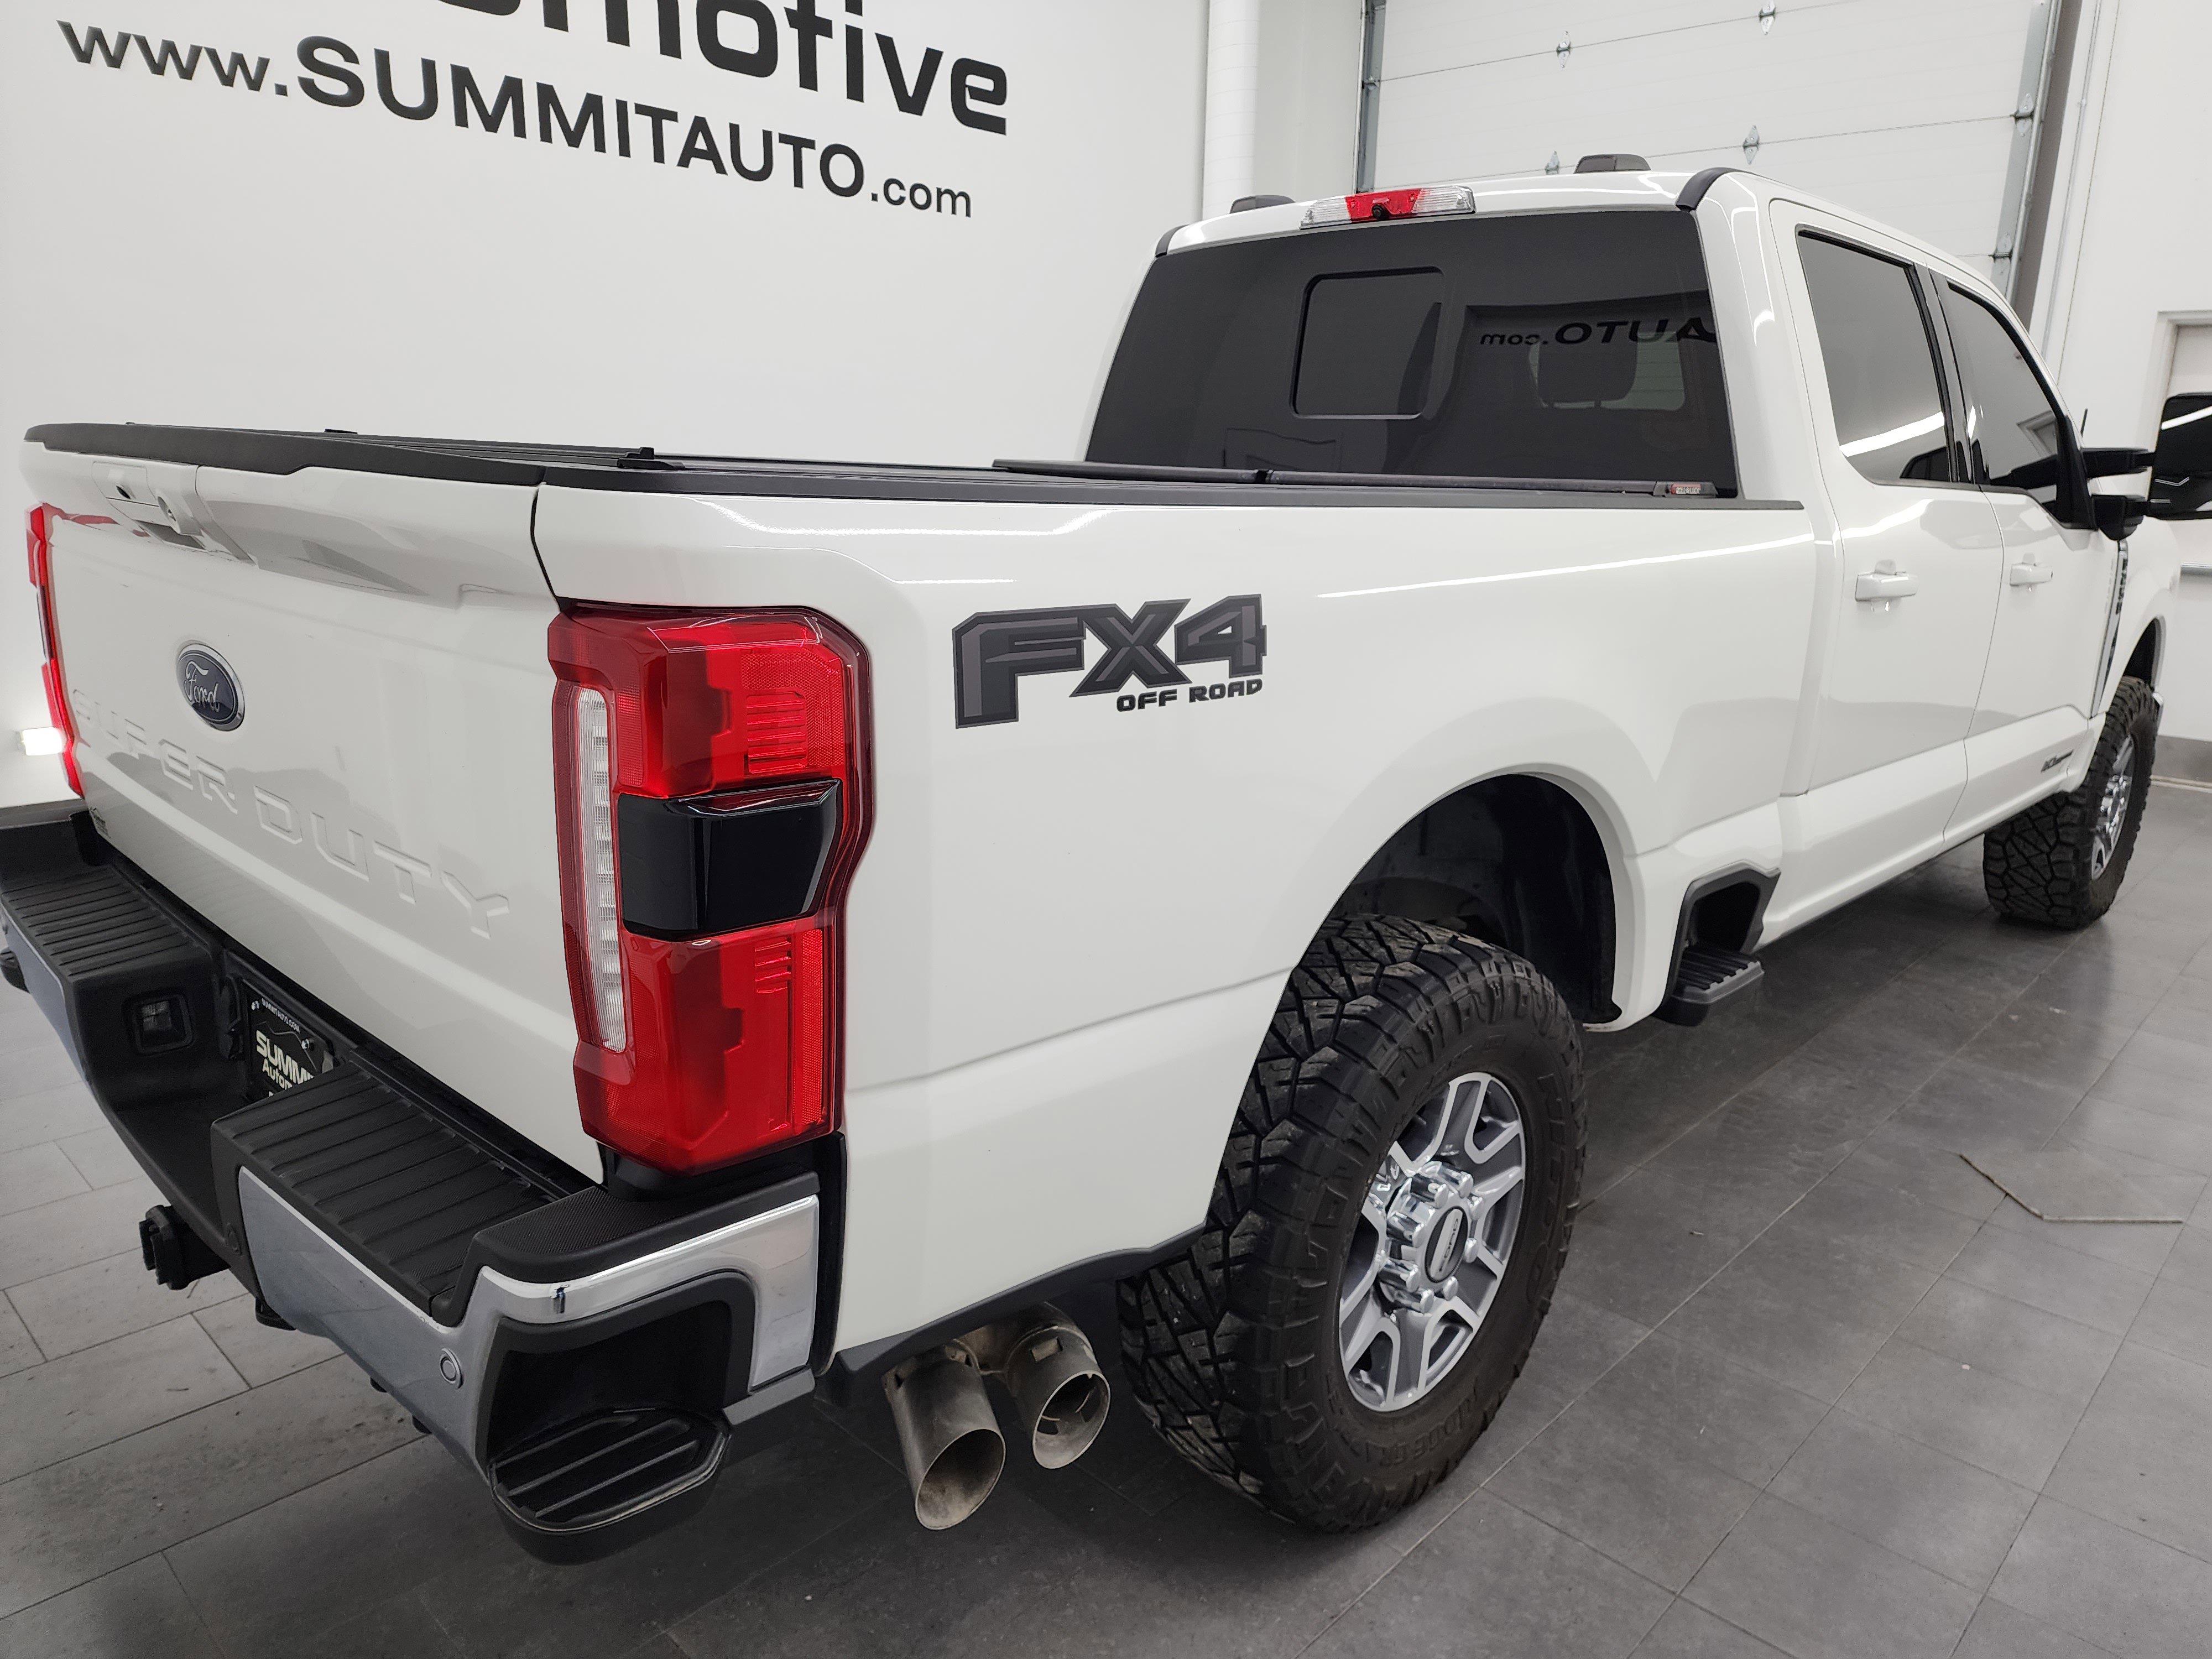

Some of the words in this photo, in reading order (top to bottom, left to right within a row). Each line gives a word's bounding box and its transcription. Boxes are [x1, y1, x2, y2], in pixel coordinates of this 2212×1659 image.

[56, 20, 972, 217] www.SUMMITAUTO.com
[439, 0, 1007, 135] motive
[184, 660, 220, 712] Ford
[952, 593, 1266, 728] FX4
[1116, 689, 1177, 712] OFF
[1189, 679, 1263, 703] ROAD
[253, 784, 509, 940] DUTY
[256, 1030, 314, 1084] SUMM
